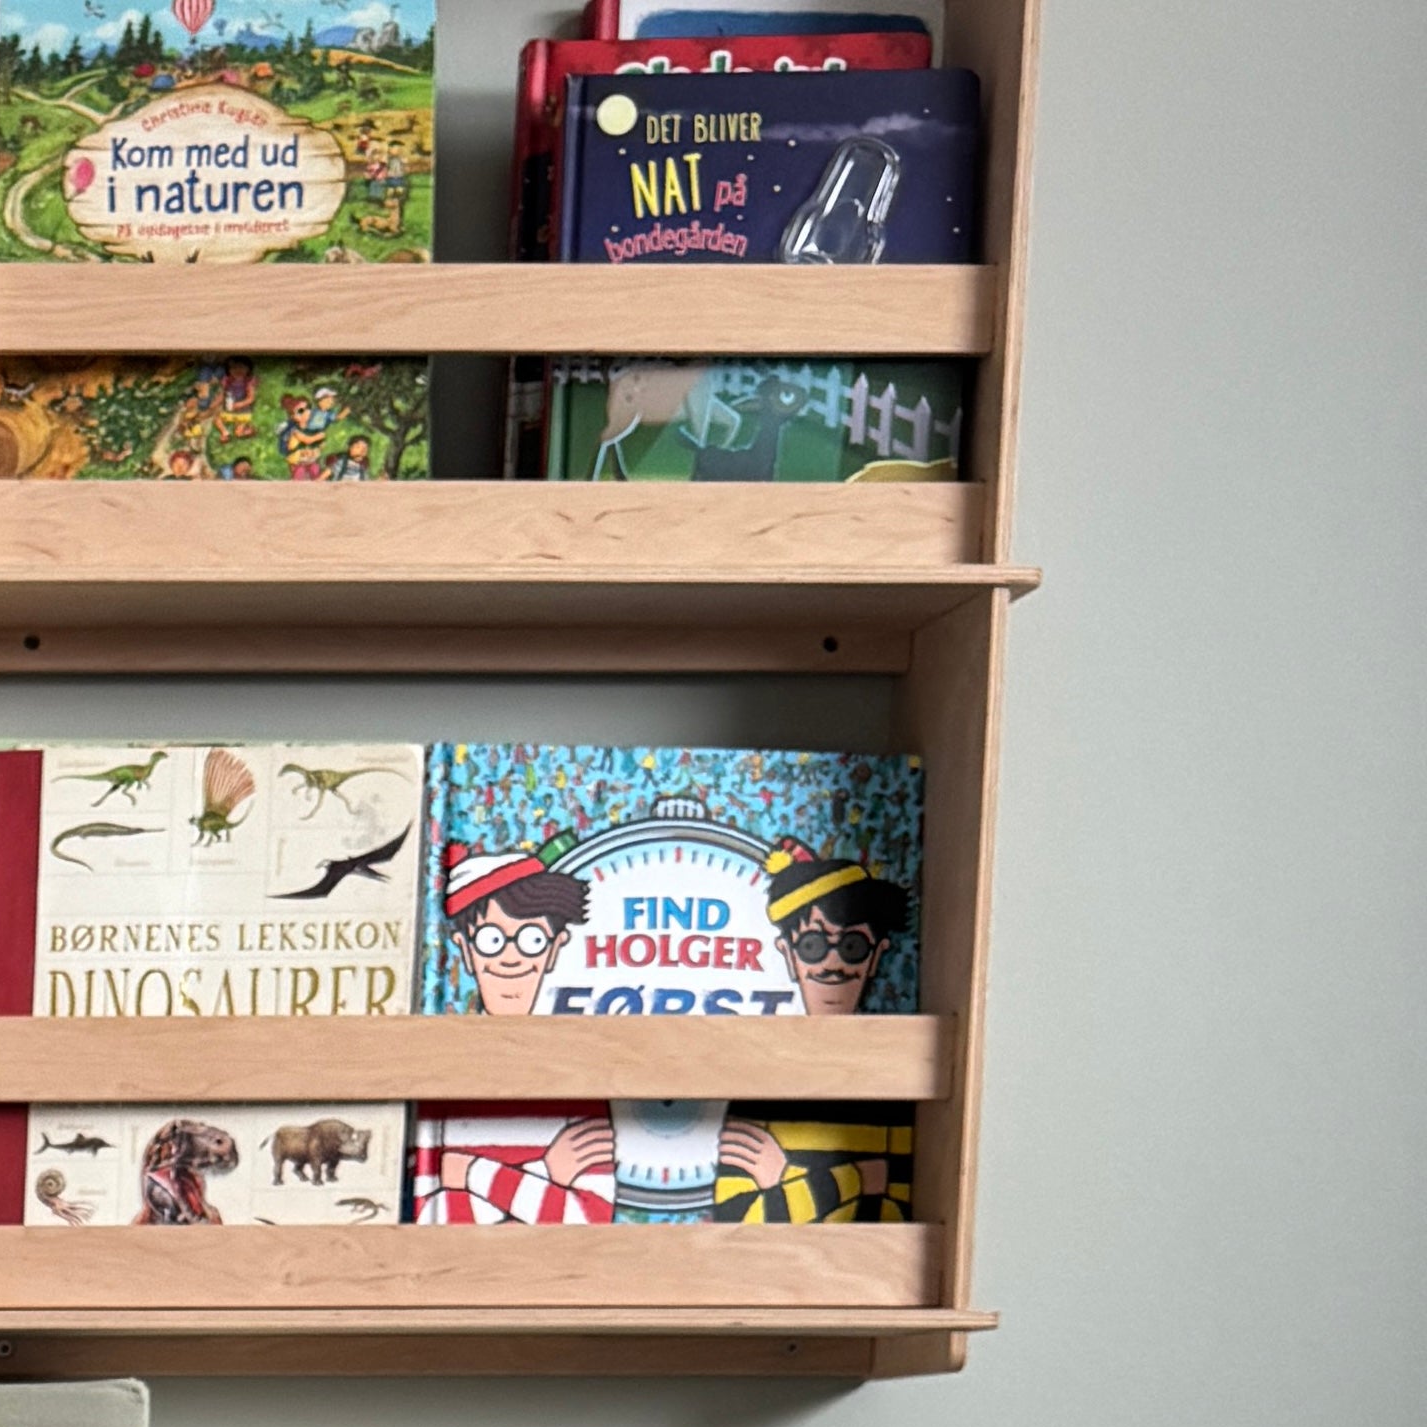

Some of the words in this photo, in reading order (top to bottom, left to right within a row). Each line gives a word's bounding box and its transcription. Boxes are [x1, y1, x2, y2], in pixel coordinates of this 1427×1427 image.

[647, 113, 680, 144] DET
[694, 112, 762, 143] BLIVER
[111, 137, 173, 170] Kom
[186, 134, 249, 168] med
[261, 133, 299, 167] ud
[108, 176, 116, 213] i
[135, 170, 304, 214] naturen
[630, 152, 702, 218] NAT
[714, 173, 747, 212] på
[604, 220, 747, 263] bondegården
[623, 896, 731, 931] FIND
[50, 923, 220, 953] BØRNENES
[238, 920, 401, 950] LEKSIKON
[585, 934, 764, 971] HOLGER
[49, 965, 397, 1017] DINOSAURER
